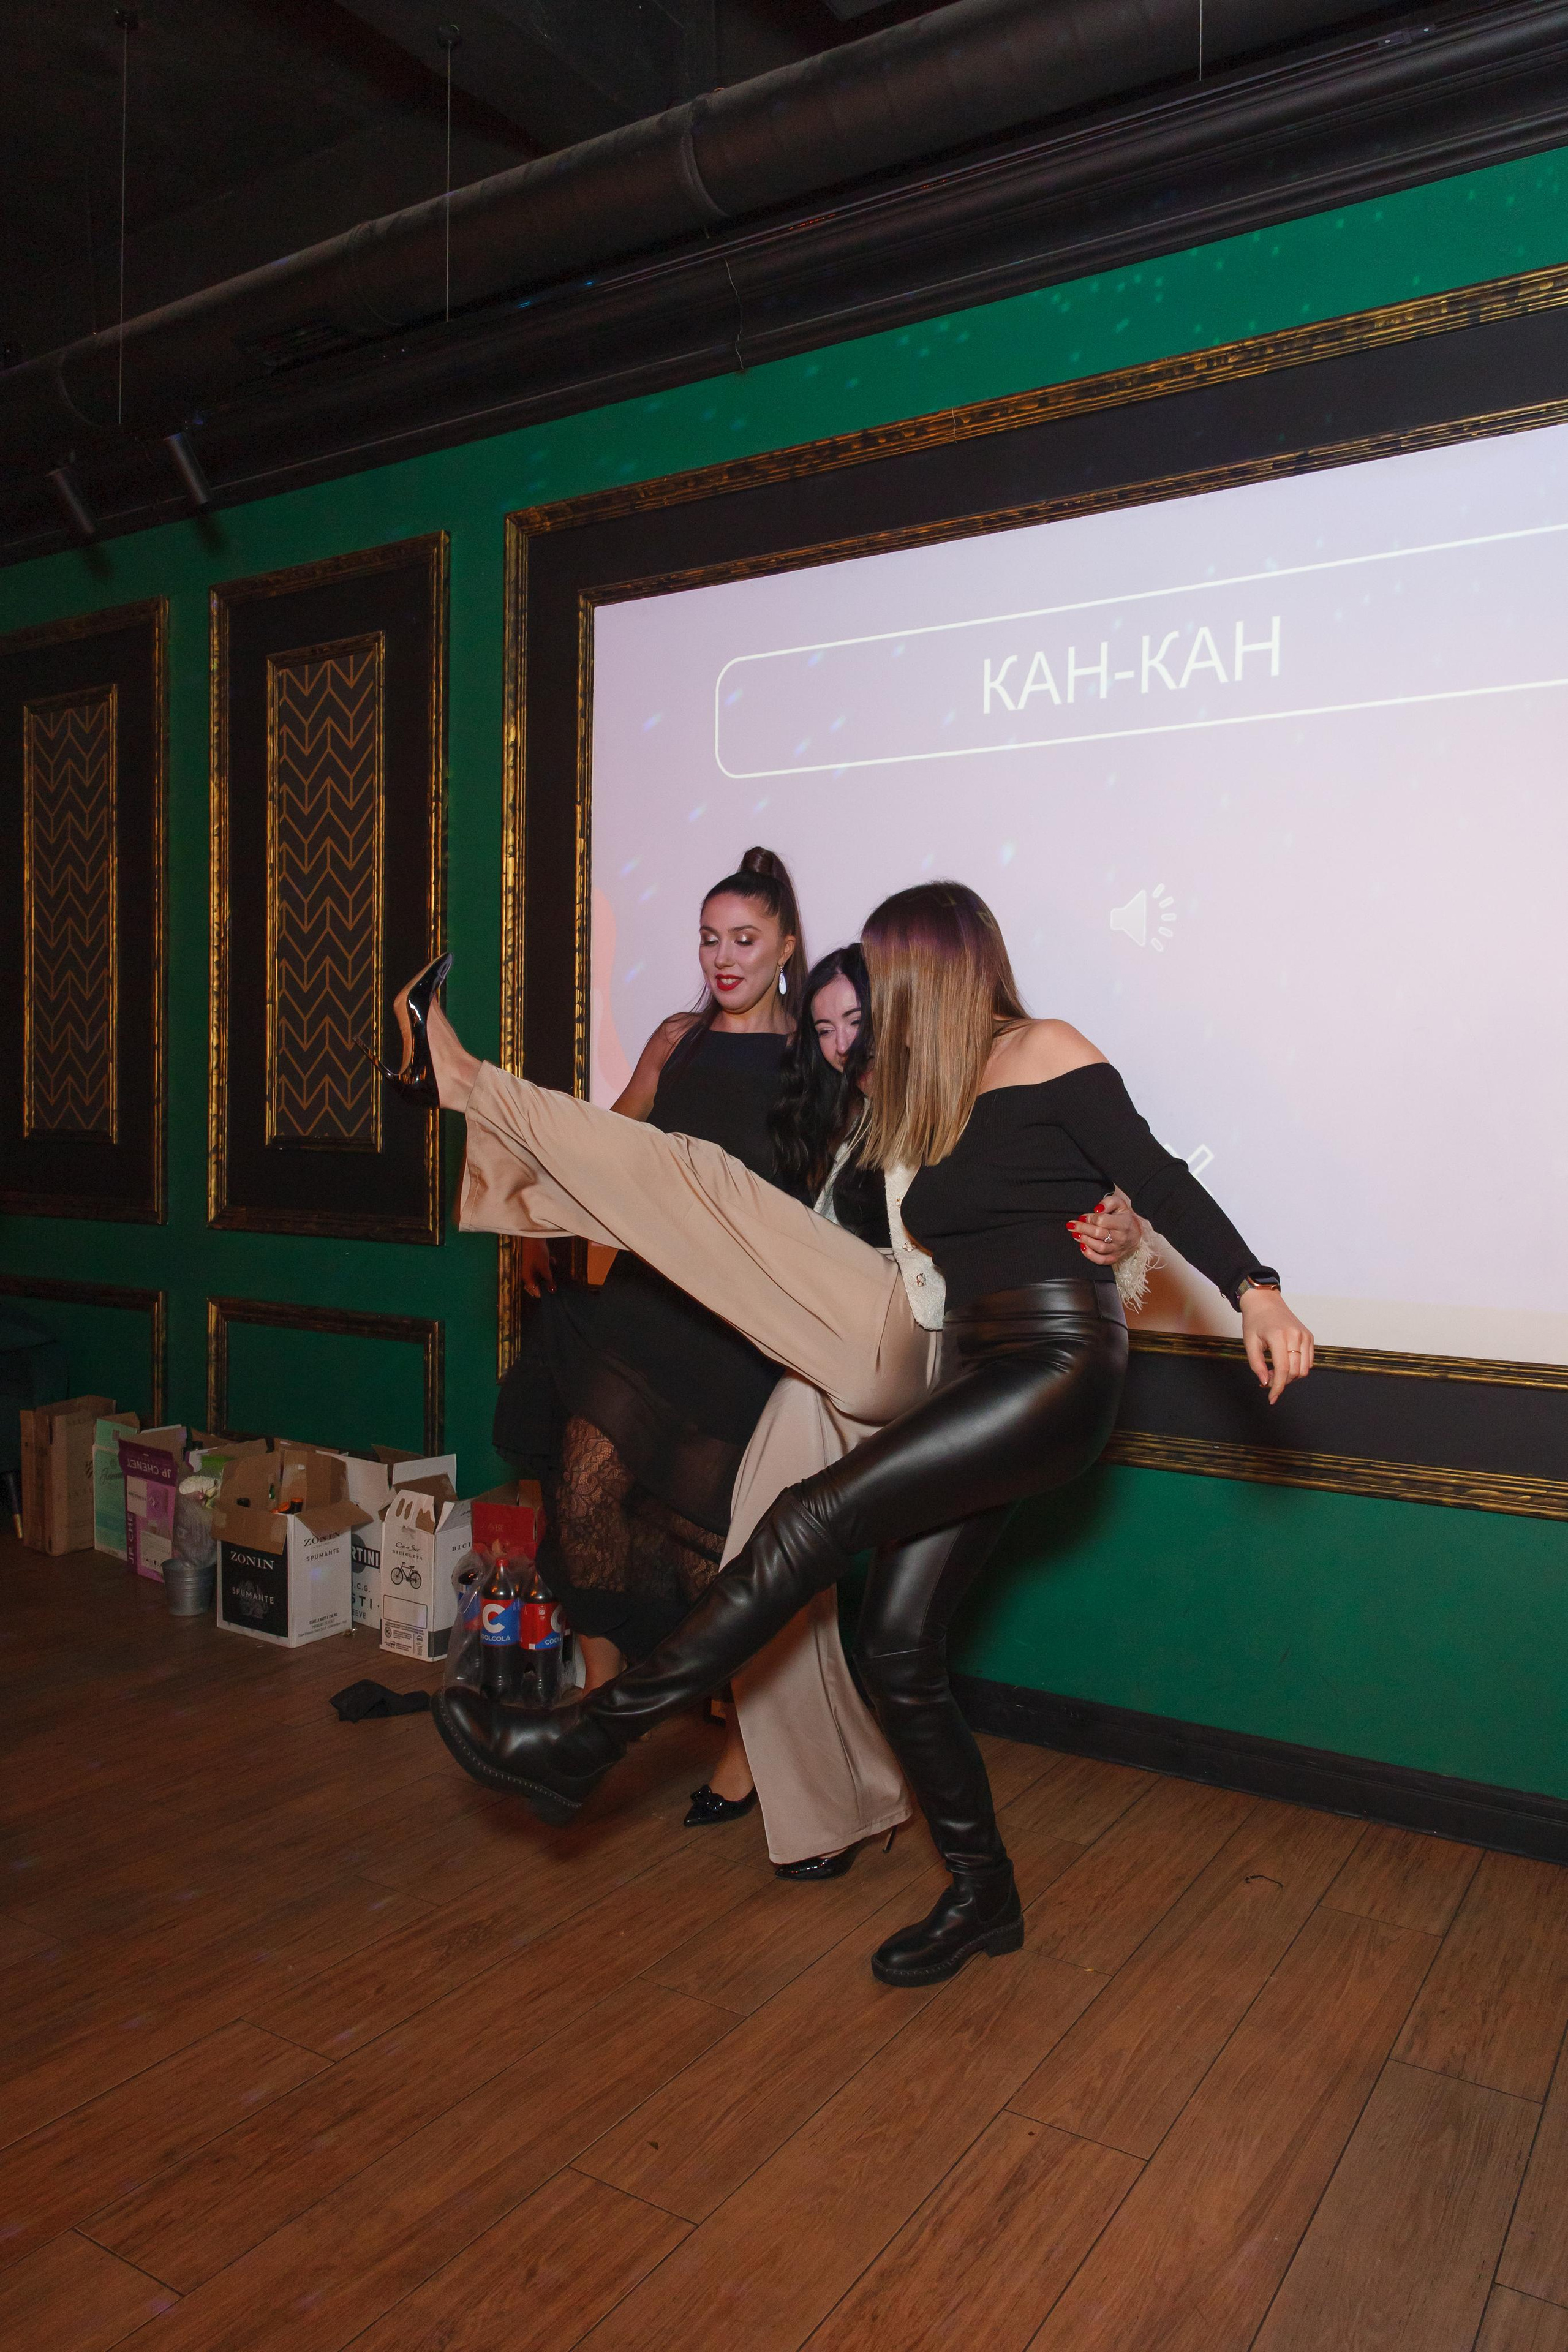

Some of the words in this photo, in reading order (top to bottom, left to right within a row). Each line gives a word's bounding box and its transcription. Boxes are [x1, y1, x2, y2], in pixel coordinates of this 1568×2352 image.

[982, 615, 1281, 714] КАН-КАН
[127, 1458, 159, 1475] CHENET
[162, 1468, 172, 1478] JP
[303, 1531, 341, 1547] ZONIN
[128, 1547, 134, 1564] JP
[230, 1550, 274, 1570] ZONIN
[306, 1547, 340, 1562] SPUMANTE
[392, 1549, 423, 1561] BICICLETA
[232, 1586, 274, 1604] SPUMANTE
